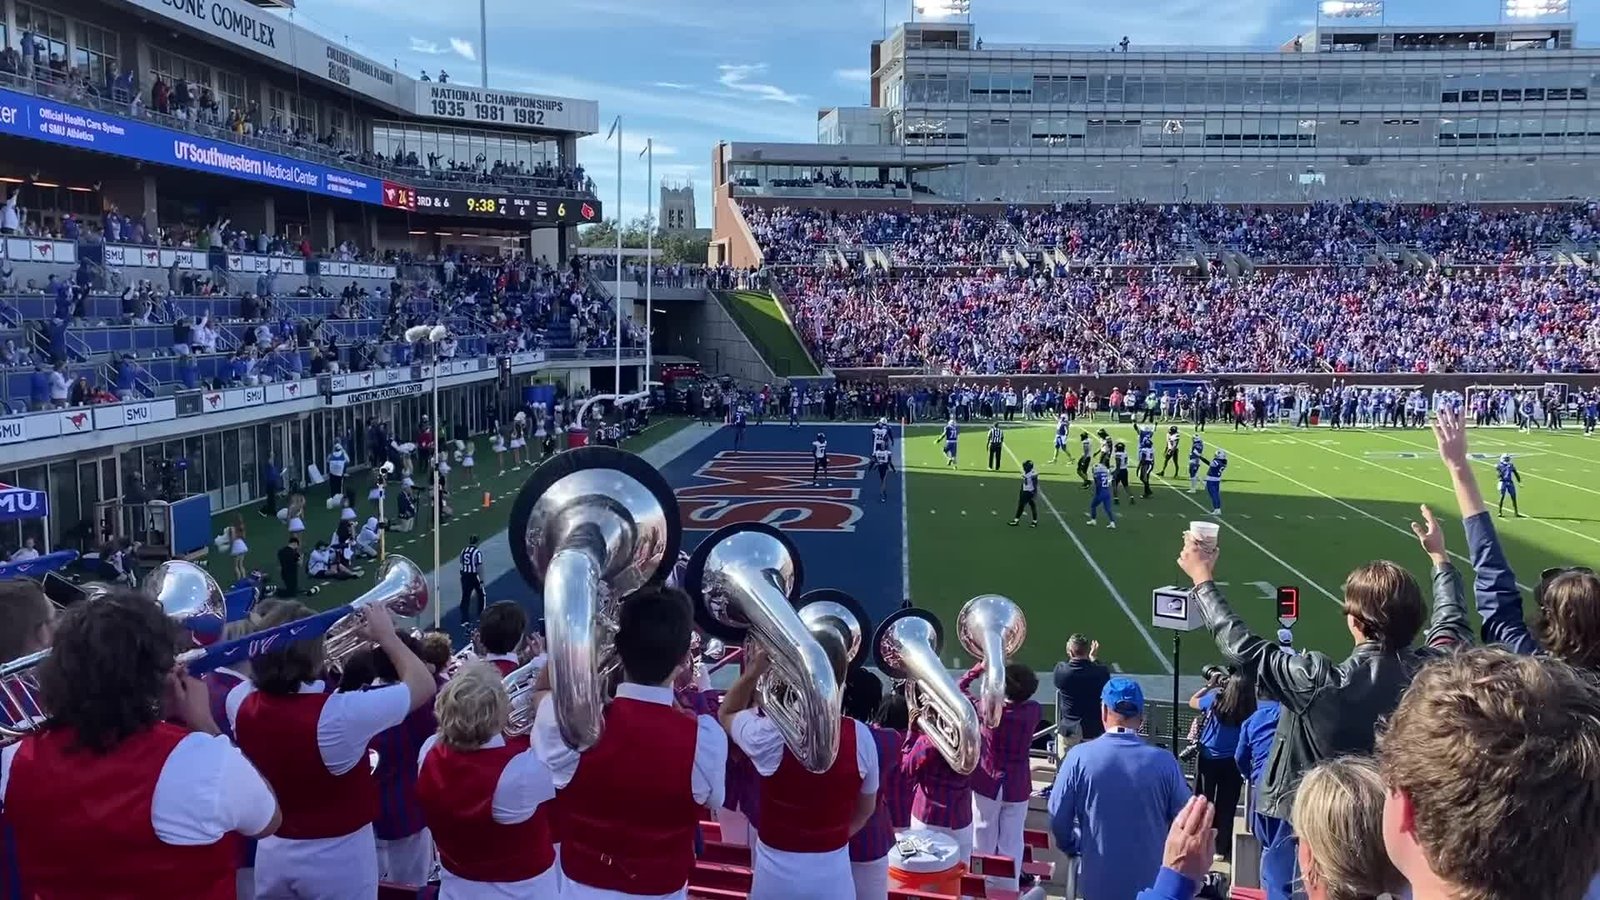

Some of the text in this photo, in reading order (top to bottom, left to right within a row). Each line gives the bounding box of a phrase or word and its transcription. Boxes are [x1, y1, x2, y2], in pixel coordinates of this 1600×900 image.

[211, 3, 276, 48] COMPLEX
[431, 87, 563, 112] NATIONAL CHAMPIONSHIPS
[0, 106, 17, 124] er
[432, 100, 544, 125] 1935 1981 1982
[39, 108, 125, 135] Official Health Care System
[40, 123, 94, 142] of SMU Athletics
[262, 160, 294, 182] Medical
[293, 167, 318, 186] Center
[416, 196, 450, 208] 3RD & 6
[467, 198, 495, 211] 9:38
[557, 202, 566, 216] 6
[519, 207, 526, 216] 6
[106, 249, 124, 261] SMU
[405, 384, 423, 394] CENTER
[246, 391, 262, 402] SMU
[127, 407, 148, 421] SMU
[464, 553, 471, 564] S
[1281, 589, 1297, 617] 3
